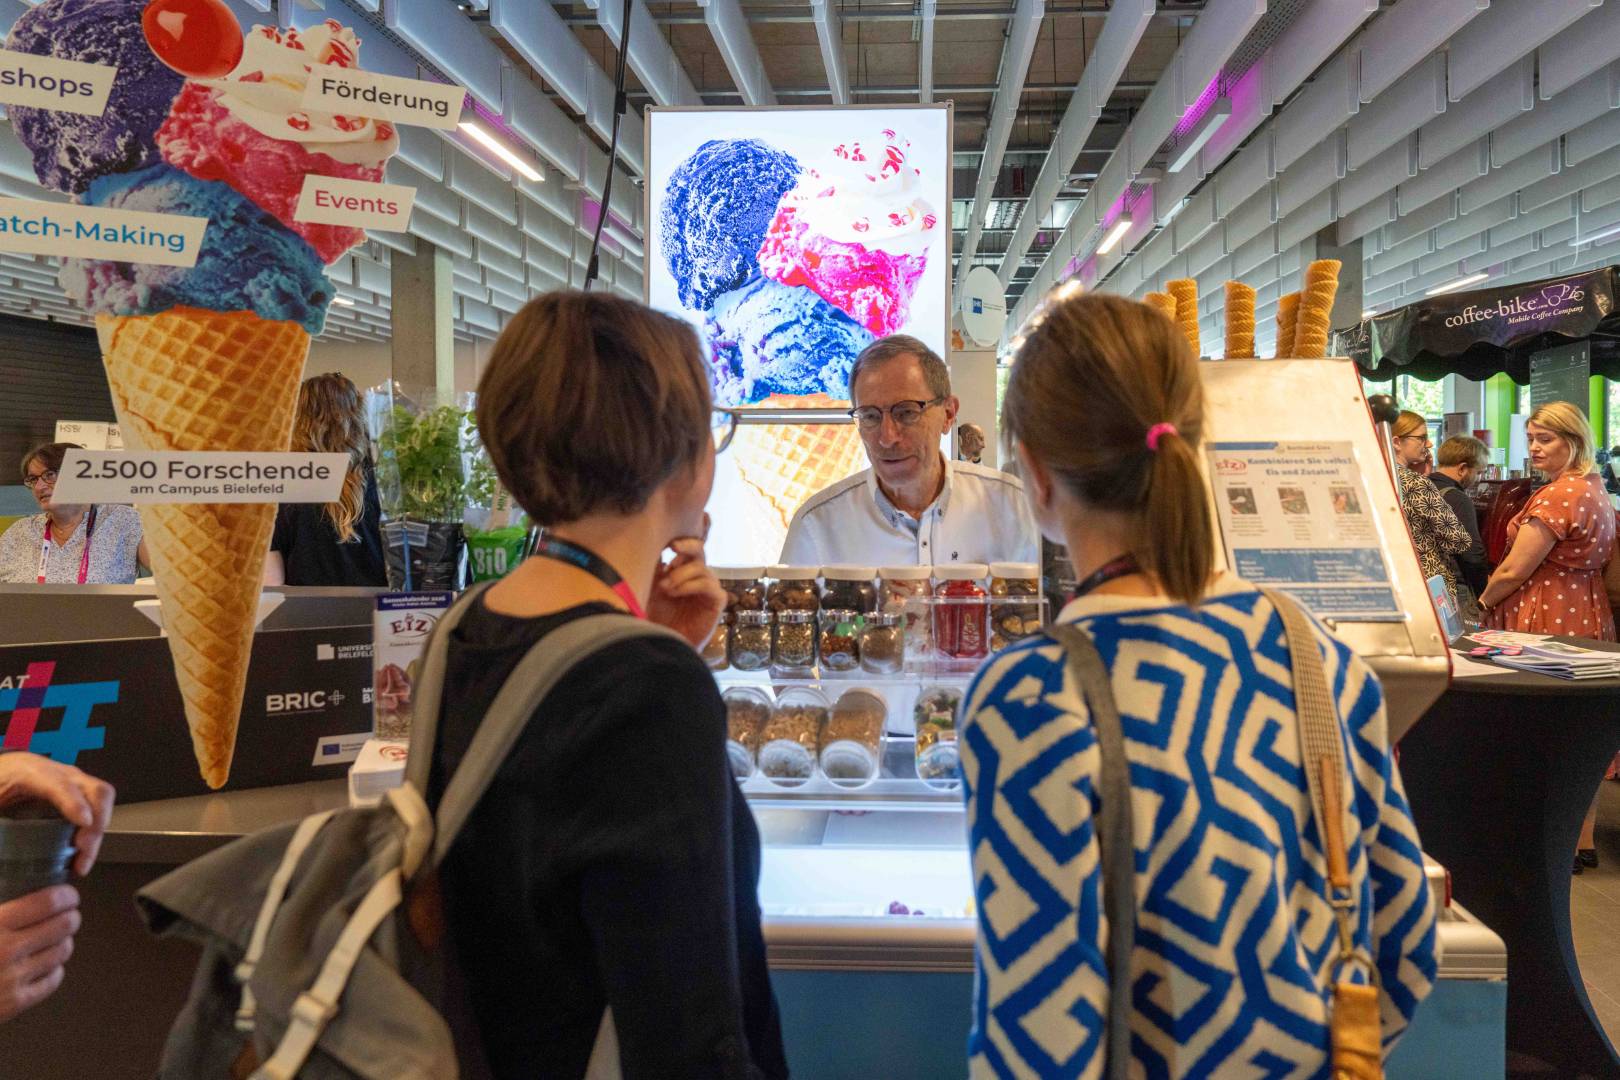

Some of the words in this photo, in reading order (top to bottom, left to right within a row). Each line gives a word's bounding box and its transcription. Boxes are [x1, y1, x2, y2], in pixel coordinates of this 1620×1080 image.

[321, 78, 449, 118] Förderung
[315, 189, 399, 216] Events
[1445, 296, 1537, 328] coffee-bike
[1507, 314, 1531, 325] Mobile
[1532, 311, 1552, 321] Coffee
[1552, 305, 1585, 317] Company
[75, 460, 158, 480] 2.500
[167, 461, 331, 480] Forschende
[130, 484, 155, 495] am
[158, 484, 219, 497] Campus
[223, 483, 284, 494] Bielefeld
